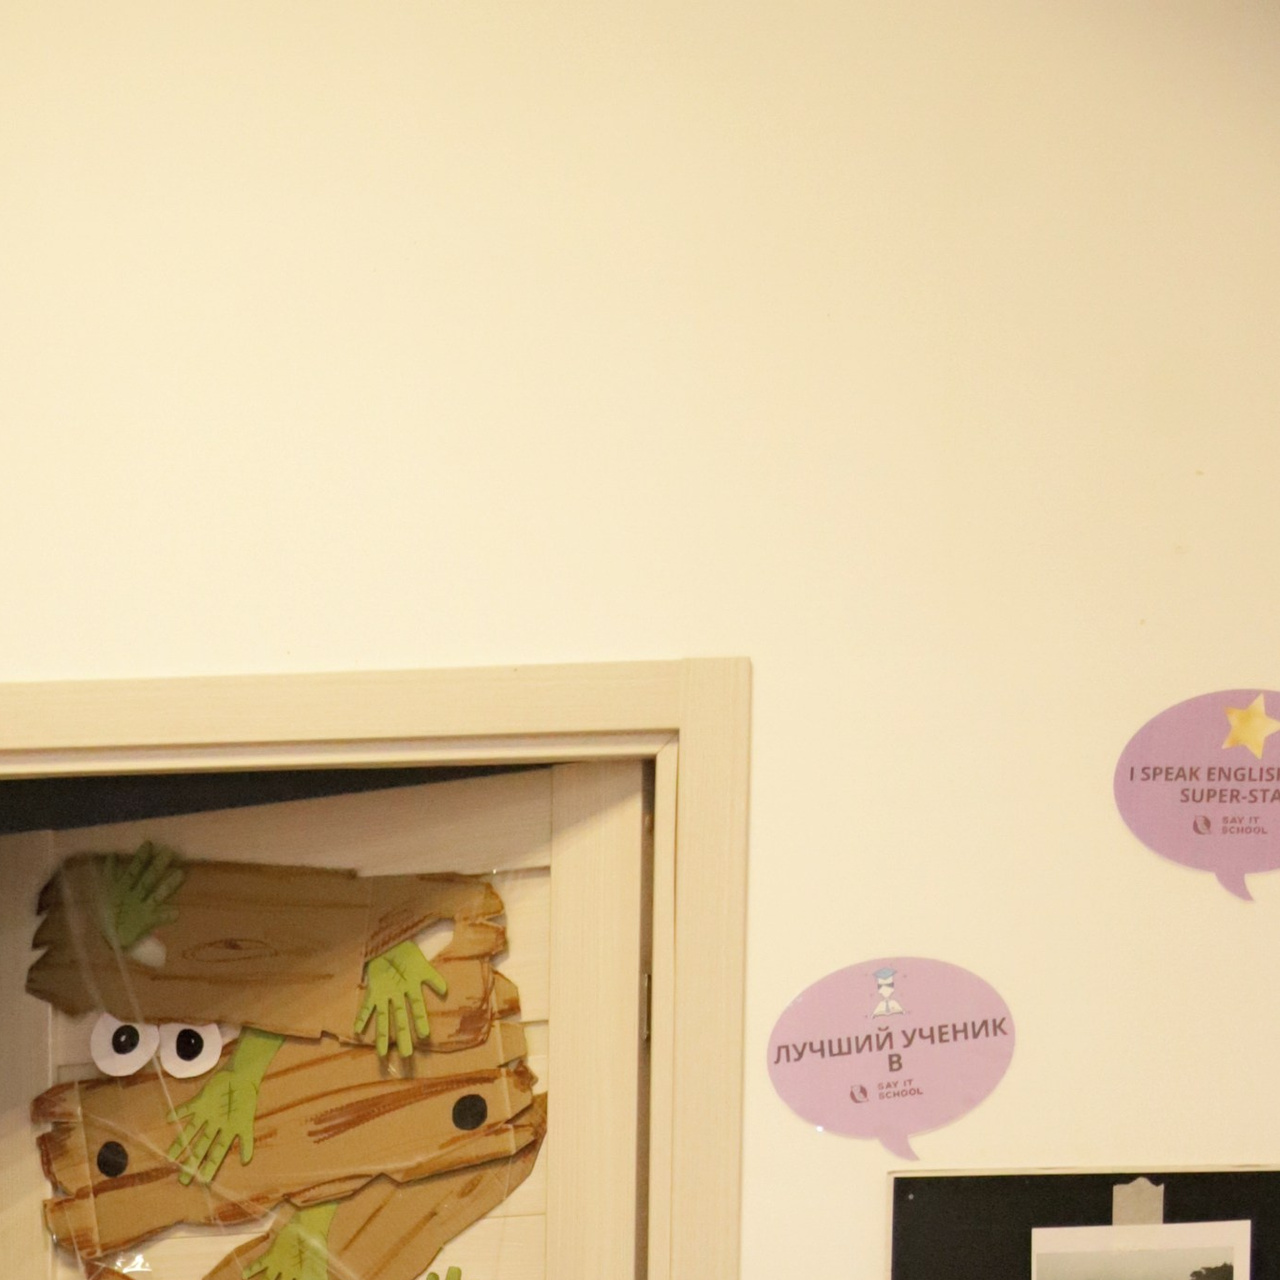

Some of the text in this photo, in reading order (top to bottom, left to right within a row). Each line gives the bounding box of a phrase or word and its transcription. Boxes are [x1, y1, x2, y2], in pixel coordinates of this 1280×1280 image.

[1129, 766, 1135, 781] I
[1140, 766, 1201, 782] SPEAK
[1179, 788, 1280, 804] SUPER-STA
[1222, 816, 1260, 825] SAY IT
[1222, 826, 1268, 835] SCHOOL
[773, 1017, 1009, 1065] ЛУЧШИЙ УЧЕНИК
[877, 1078, 914, 1091] SAY IT
[878, 1087, 923, 1100] SCHOOL
